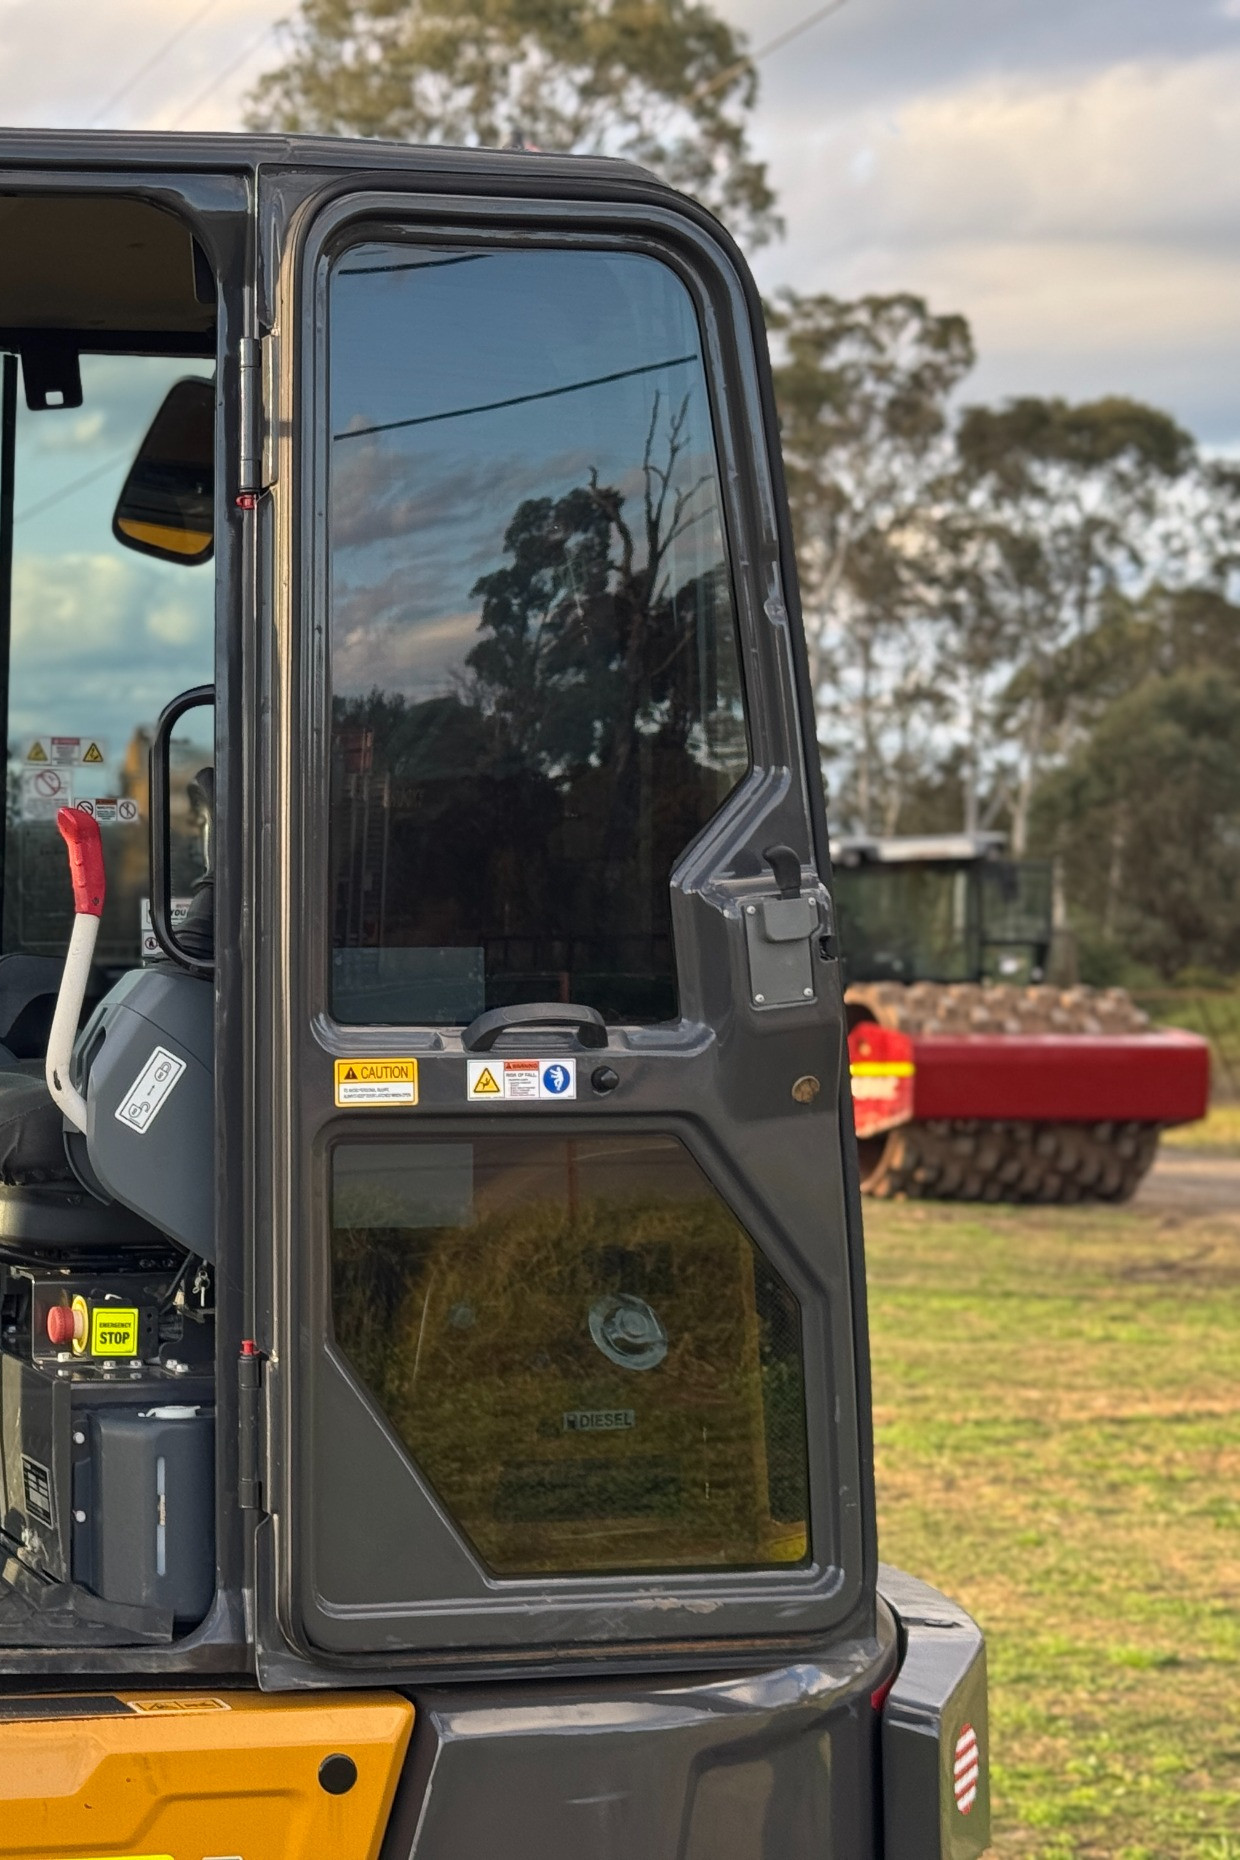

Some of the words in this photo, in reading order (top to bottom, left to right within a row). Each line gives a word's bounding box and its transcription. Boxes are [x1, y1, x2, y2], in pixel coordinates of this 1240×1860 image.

[361, 1065, 409, 1079] CAUTION
[99, 1331, 131, 1345] STOP
[579, 1412, 632, 1428] DIESEL
